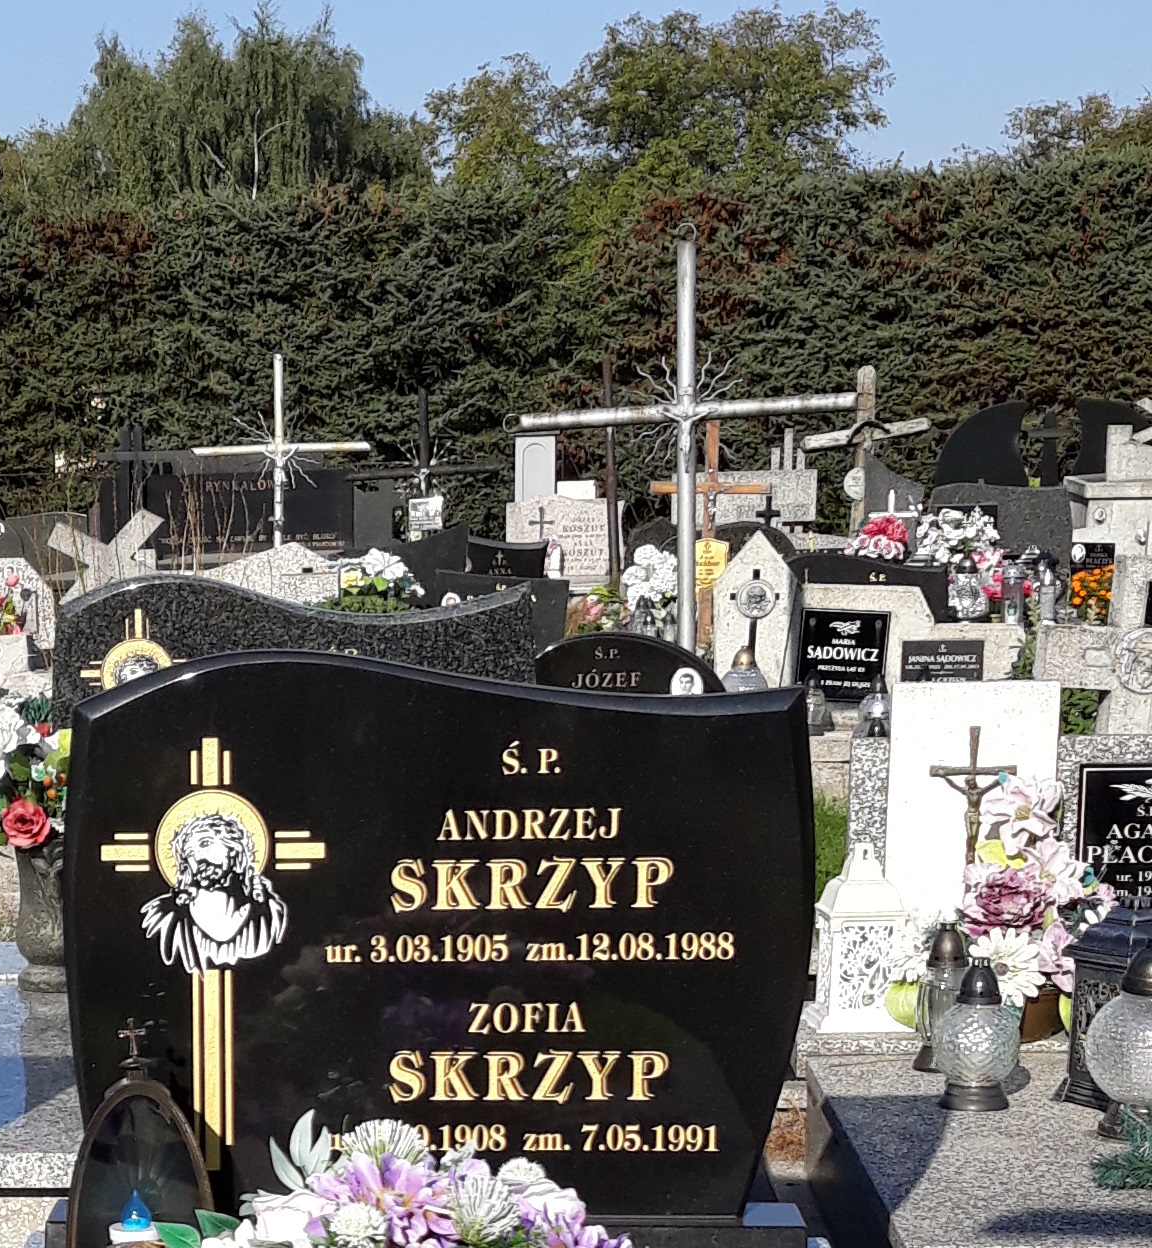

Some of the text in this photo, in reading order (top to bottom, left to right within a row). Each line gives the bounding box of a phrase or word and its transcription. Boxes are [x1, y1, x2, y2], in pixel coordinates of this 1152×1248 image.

[571, 667, 642, 689] JÓZEF
[500, 740, 562, 776] Ś. P.
[435, 806, 623, 842] ANDRZEJ
[389, 855, 675, 914] SKRZYP
[324, 942, 362, 963] ur.
[369, 933, 510, 964] 3.03.1905
[467, 1001, 587, 1035] ZOFIA
[387, 1049, 670, 1105] SKRZYP
[521, 1130, 572, 1152] zm.
[580, 1123, 720, 1152] 7.05.1991
